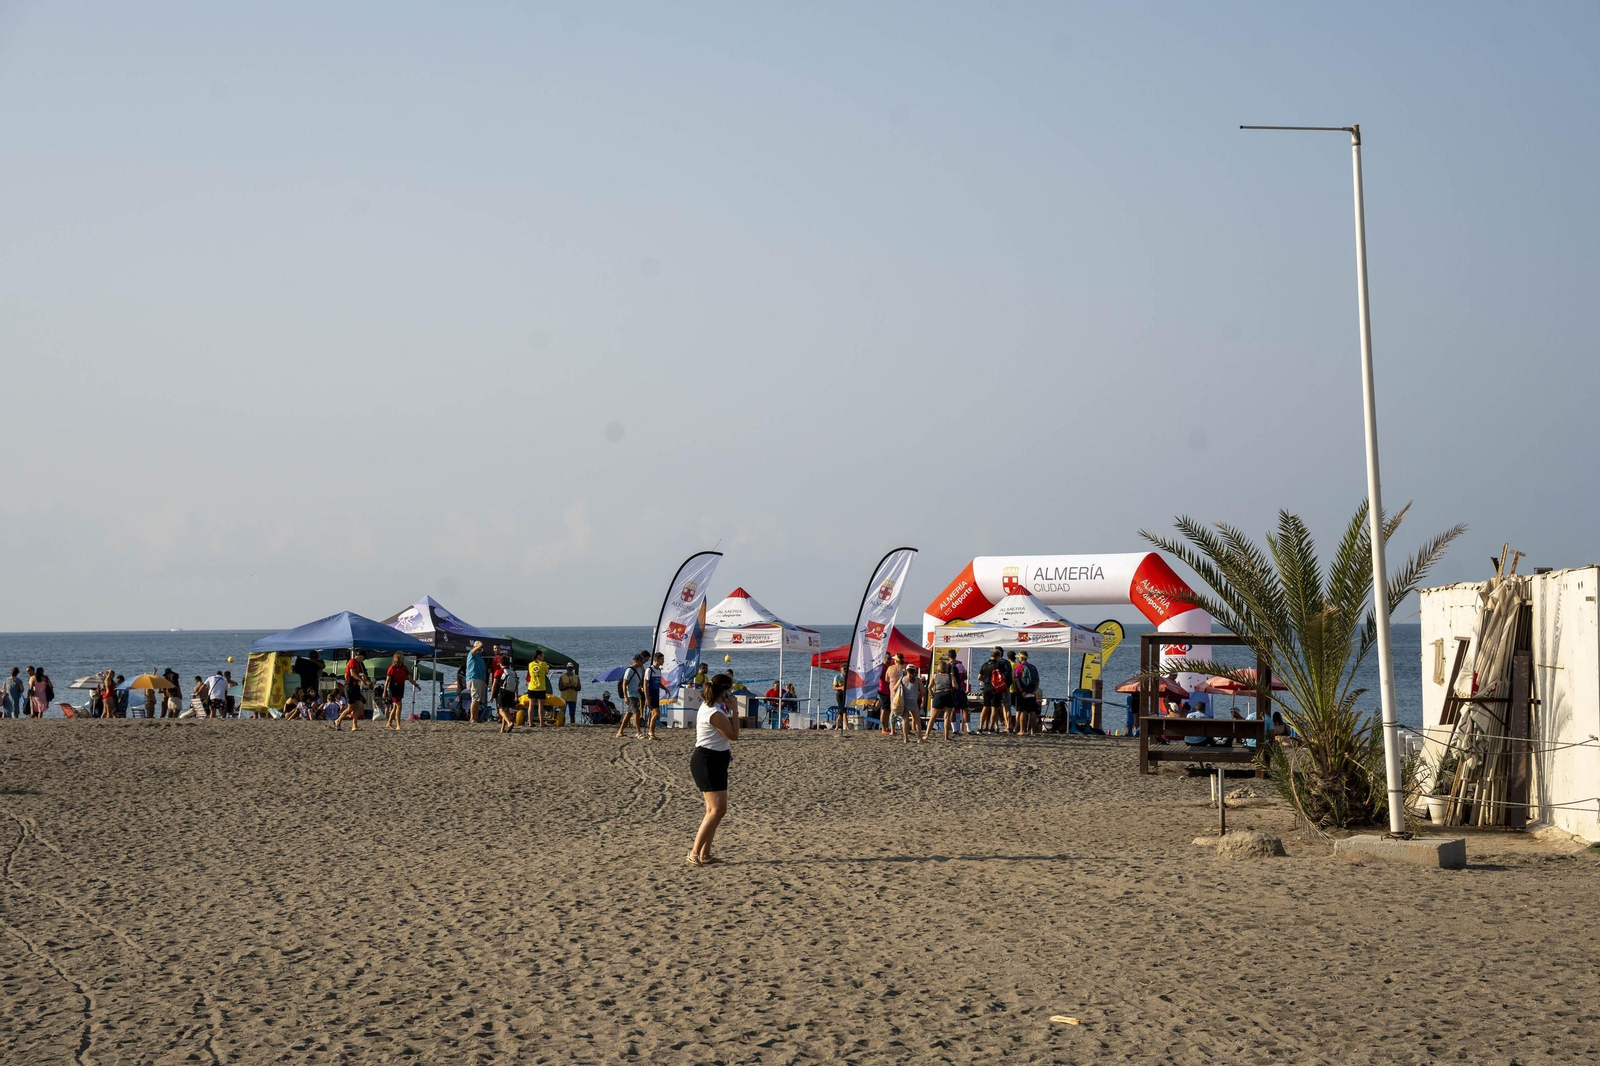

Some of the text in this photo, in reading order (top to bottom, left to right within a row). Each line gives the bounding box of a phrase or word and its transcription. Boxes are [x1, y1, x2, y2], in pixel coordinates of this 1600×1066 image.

[1033, 563, 1105, 581] ALMERÍA
[939, 580, 968, 610] ALMERÍA
[1033, 583, 1071, 593] CIUDAD
[1135, 585, 1143, 595] es
[944, 586, 974, 616] es deporte
